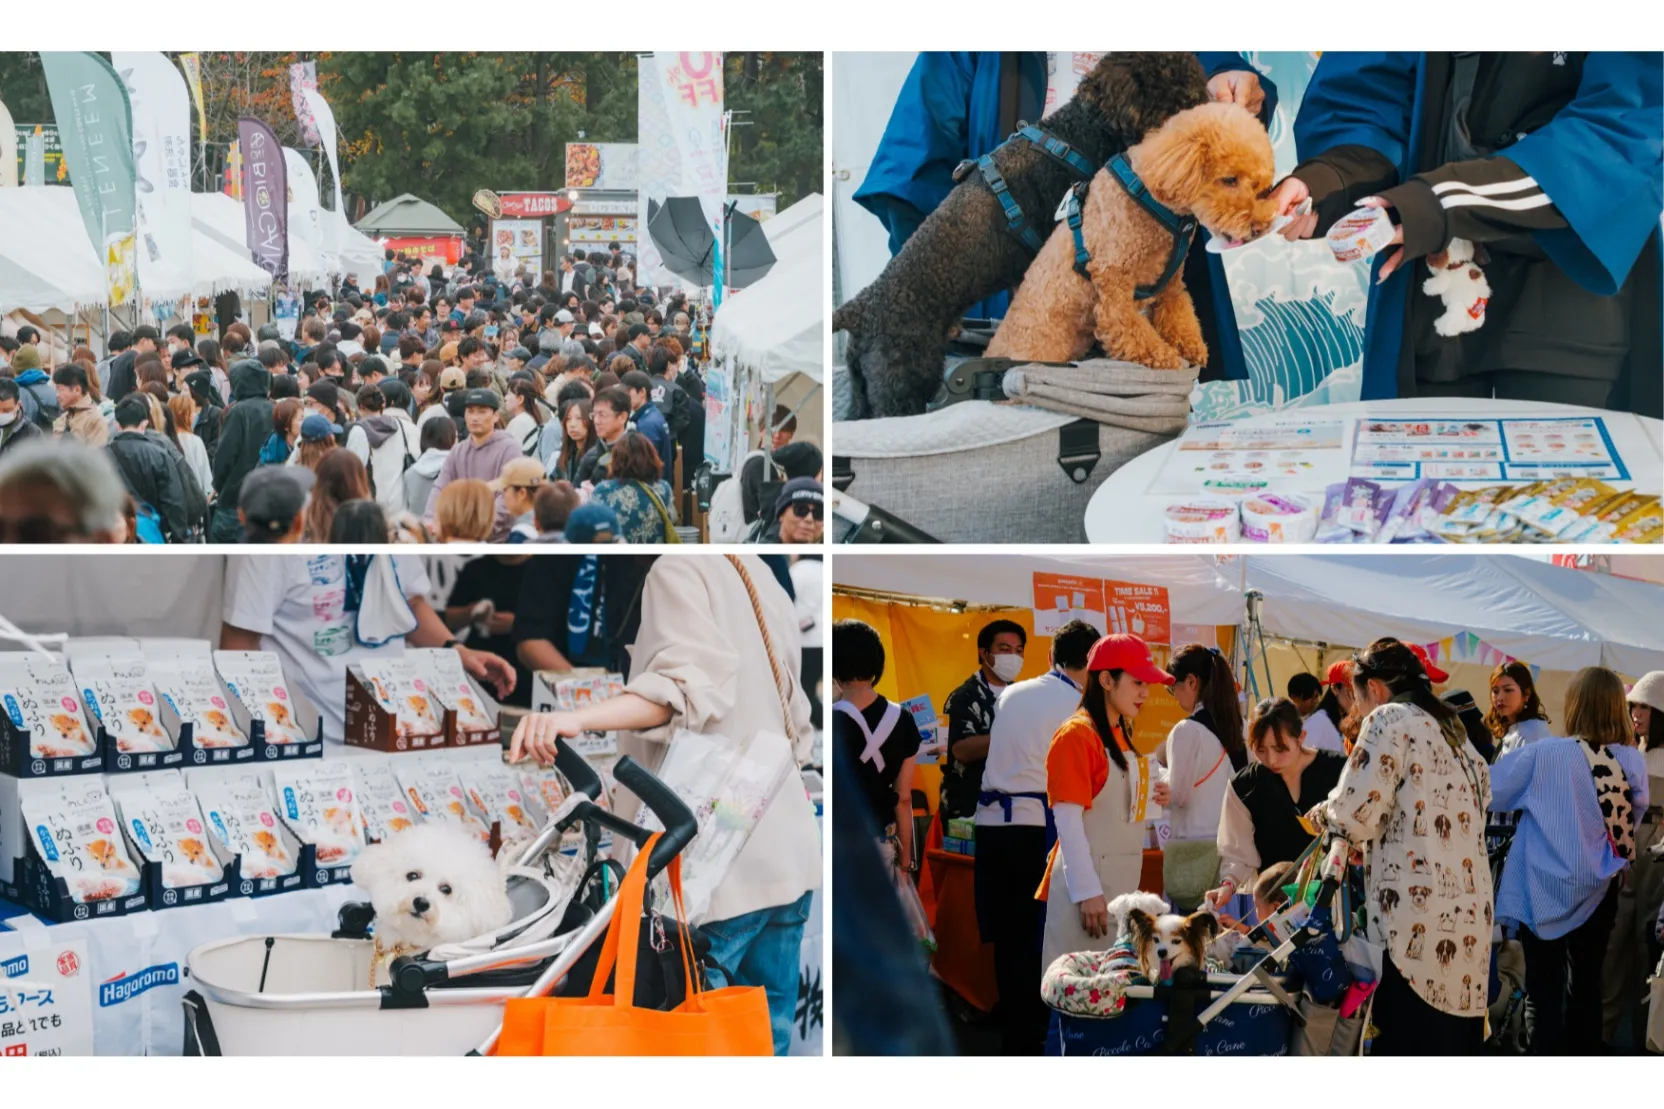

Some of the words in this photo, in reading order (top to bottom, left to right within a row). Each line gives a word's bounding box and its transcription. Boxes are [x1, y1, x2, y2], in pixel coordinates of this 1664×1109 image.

[523, 197, 558, 213] TACOS
[1114, 587, 1133, 595] TIME
[1134, 587, 1153, 595] SALE
[103, 966, 177, 1005] Hagoromo
[1135, 1035, 1151, 1049] Ca
[1216, 1040, 1246, 1055] Cane
